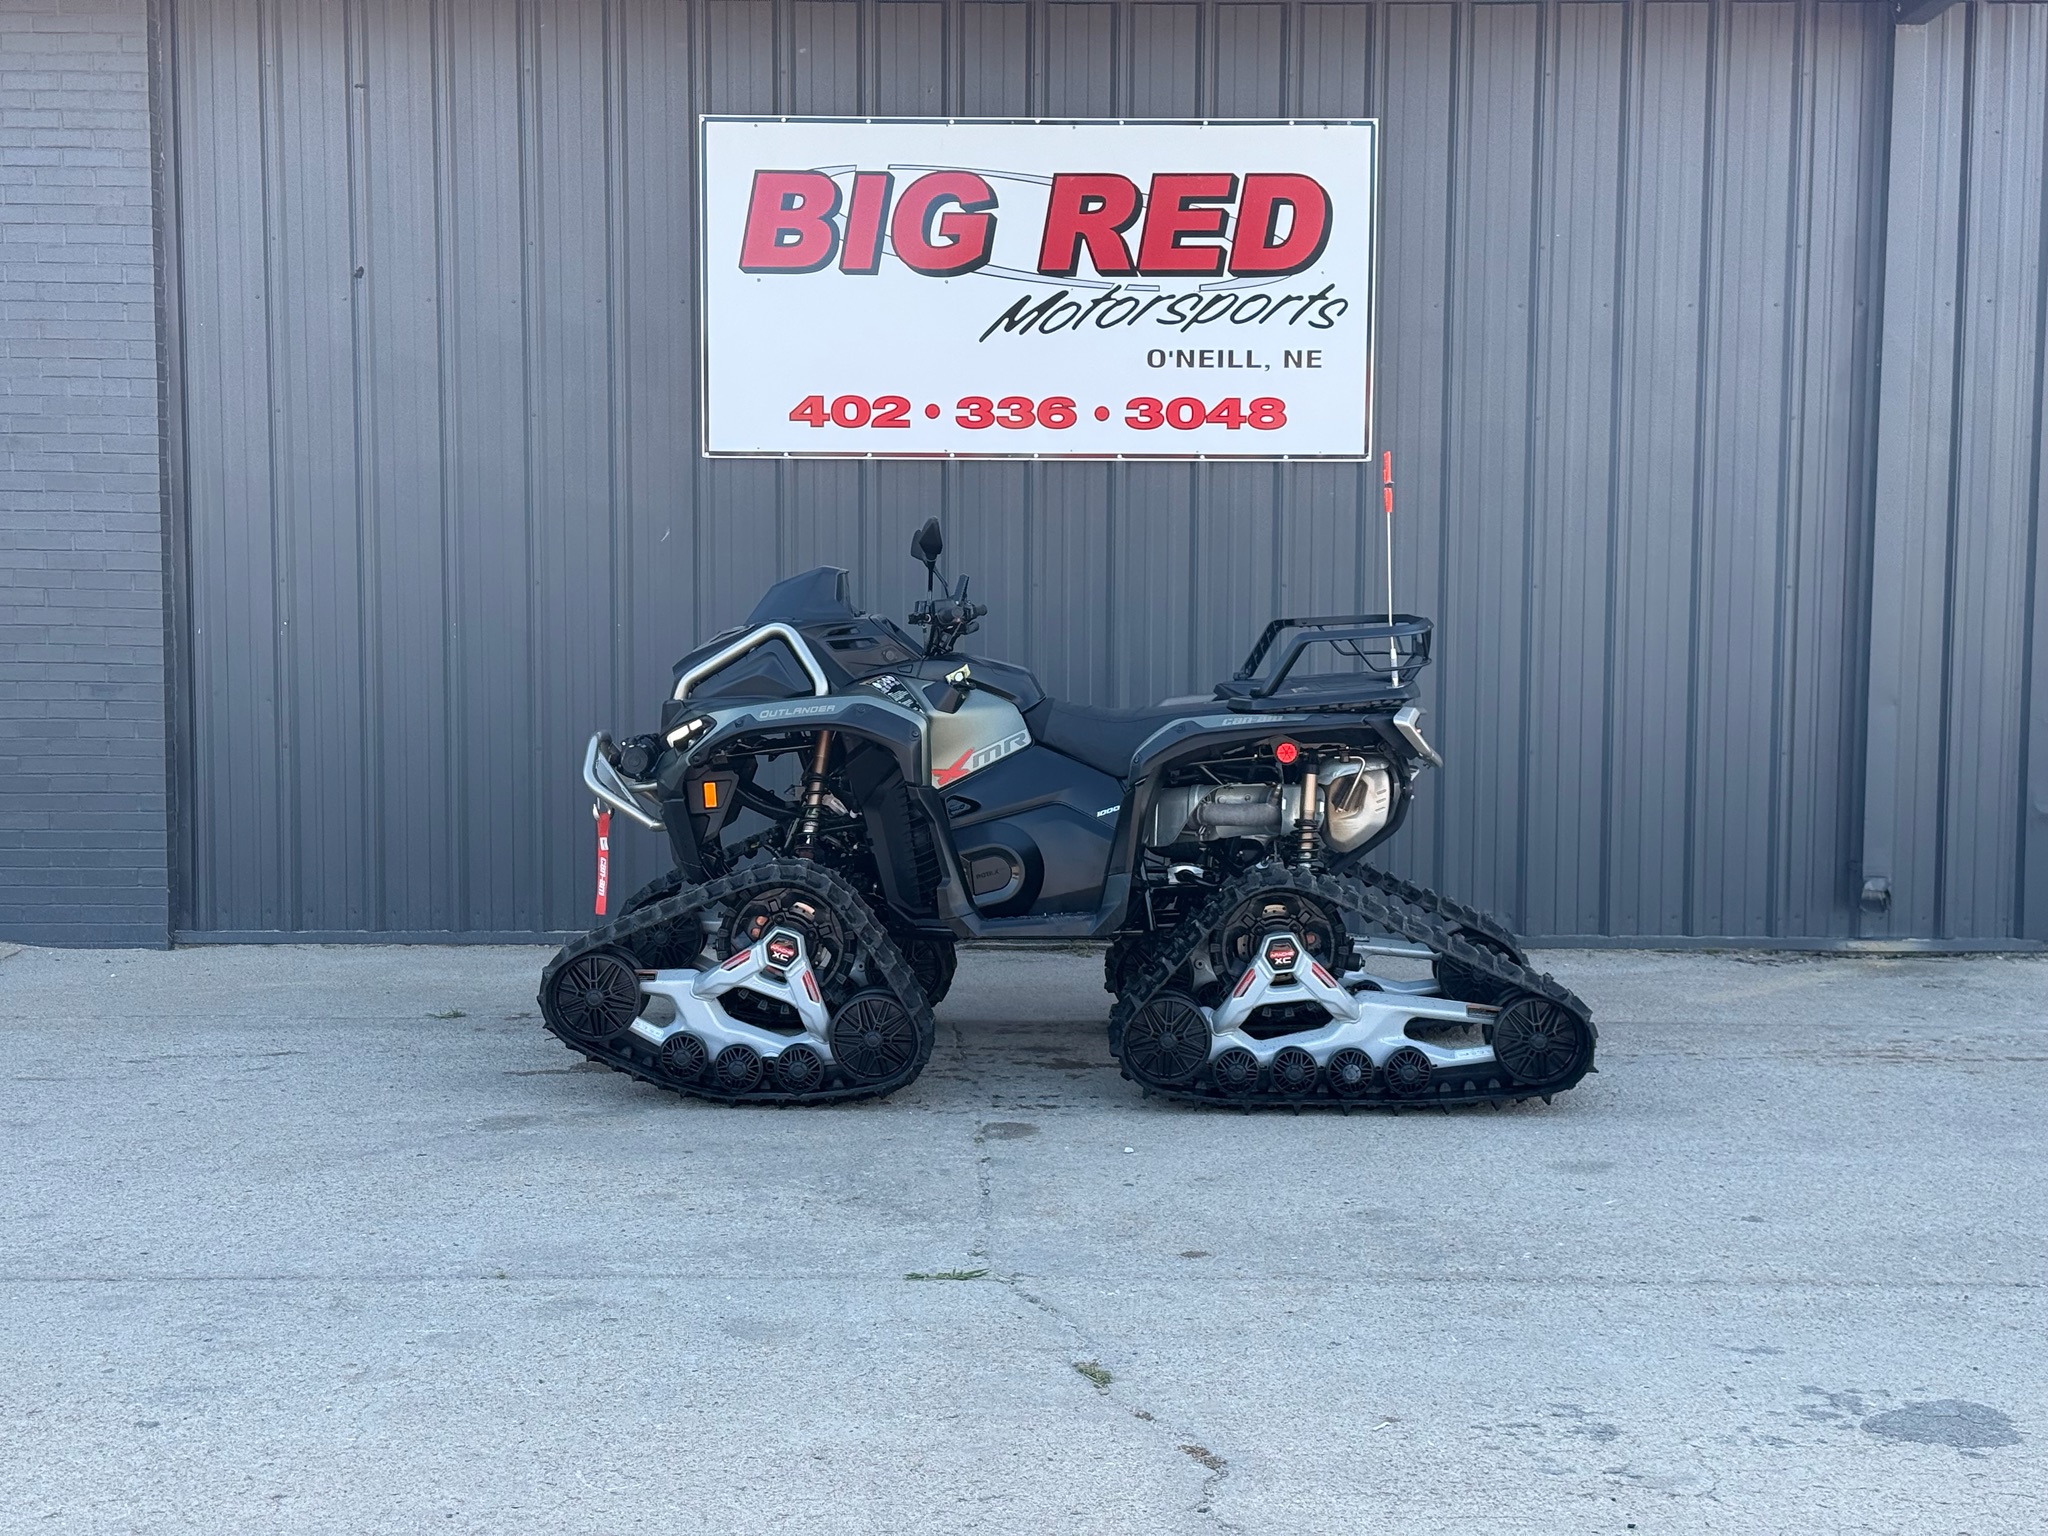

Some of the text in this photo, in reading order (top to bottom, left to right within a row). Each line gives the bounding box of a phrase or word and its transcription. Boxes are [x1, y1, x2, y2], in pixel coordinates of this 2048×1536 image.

[738, 169, 1333, 277] BIG RED
[979, 284, 1349, 342] Motorsports
[1147, 348, 1323, 371] O'NEILL, NE
[788, 395, 1288, 431] 402 336 3048
[1096, 804, 1121, 818] 1000
[771, 951, 790, 962] XC
[1274, 956, 1292, 965] XC
